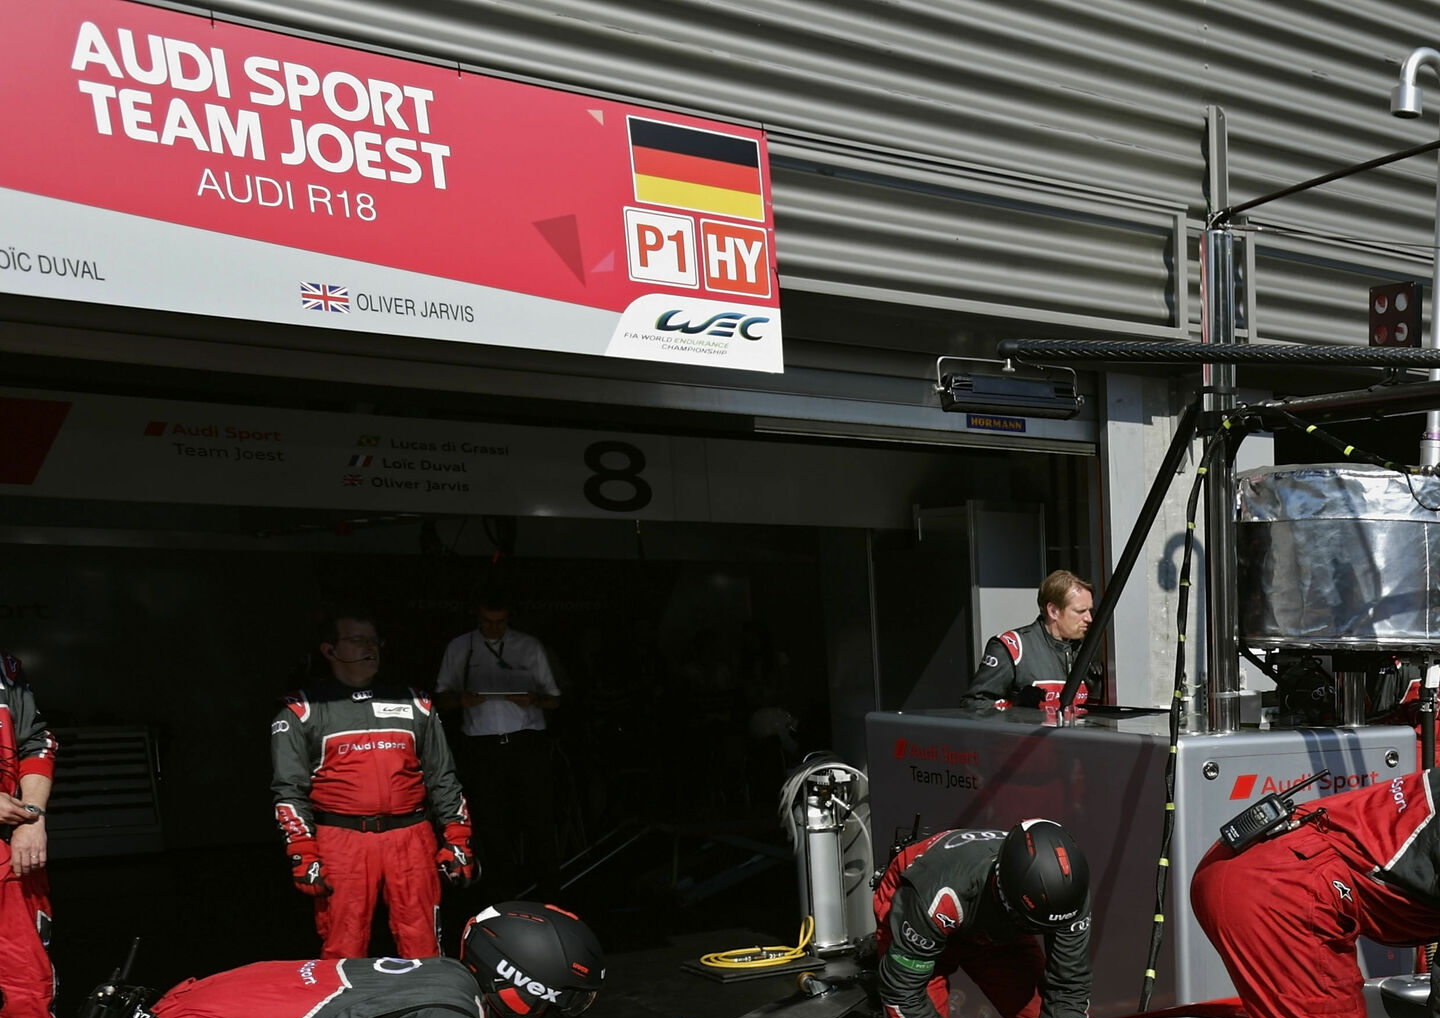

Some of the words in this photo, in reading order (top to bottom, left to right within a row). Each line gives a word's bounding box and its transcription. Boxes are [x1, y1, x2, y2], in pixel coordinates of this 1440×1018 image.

[71, 21, 231, 99] AUDI
[243, 55, 434, 134] SPORT
[77, 79, 266, 161] TEAM
[280, 118, 451, 190] JOEST
[197, 168, 294, 210] AUDI
[307, 183, 377, 222] R18
[636, 223, 687, 273] P1
[706, 233, 763, 283] HY
[38, 254, 106, 281] DUVAL
[356, 293, 416, 316] OLIVER
[420, 301, 475, 322] JARVIS
[655, 309, 770, 341] WEC
[641, 334, 673, 343] WORLD
[673, 337, 729, 349] ENDURANCE
[661, 343, 728, 355] CHAMPIONSHIP
[172, 423, 218, 438] Audi
[225, 426, 281, 442] Sport
[173, 443, 229, 458] Team
[234, 447, 284, 462] Joest
[390, 438, 437, 452] Lucas
[441, 440, 457, 452] di
[462, 442, 510, 456] Grassi
[383, 458, 416, 471] Loïc
[421, 460, 466, 473] Duval
[583, 440, 652, 511] 8
[372, 476, 419, 490] Oliver
[425, 479, 469, 493] Jarvis
[352, 743, 376, 751] Audi
[910, 743, 938, 760] Audi
[941, 745, 979, 765] Sport
[910, 765, 943, 785] Team
[946, 769, 978, 789] Joest
[1261, 773, 1312, 794] Audi
[1319, 771, 1380, 796] Sport
[1049, 910, 1078, 921] uvex
[496, 959, 562, 1003] uvex
